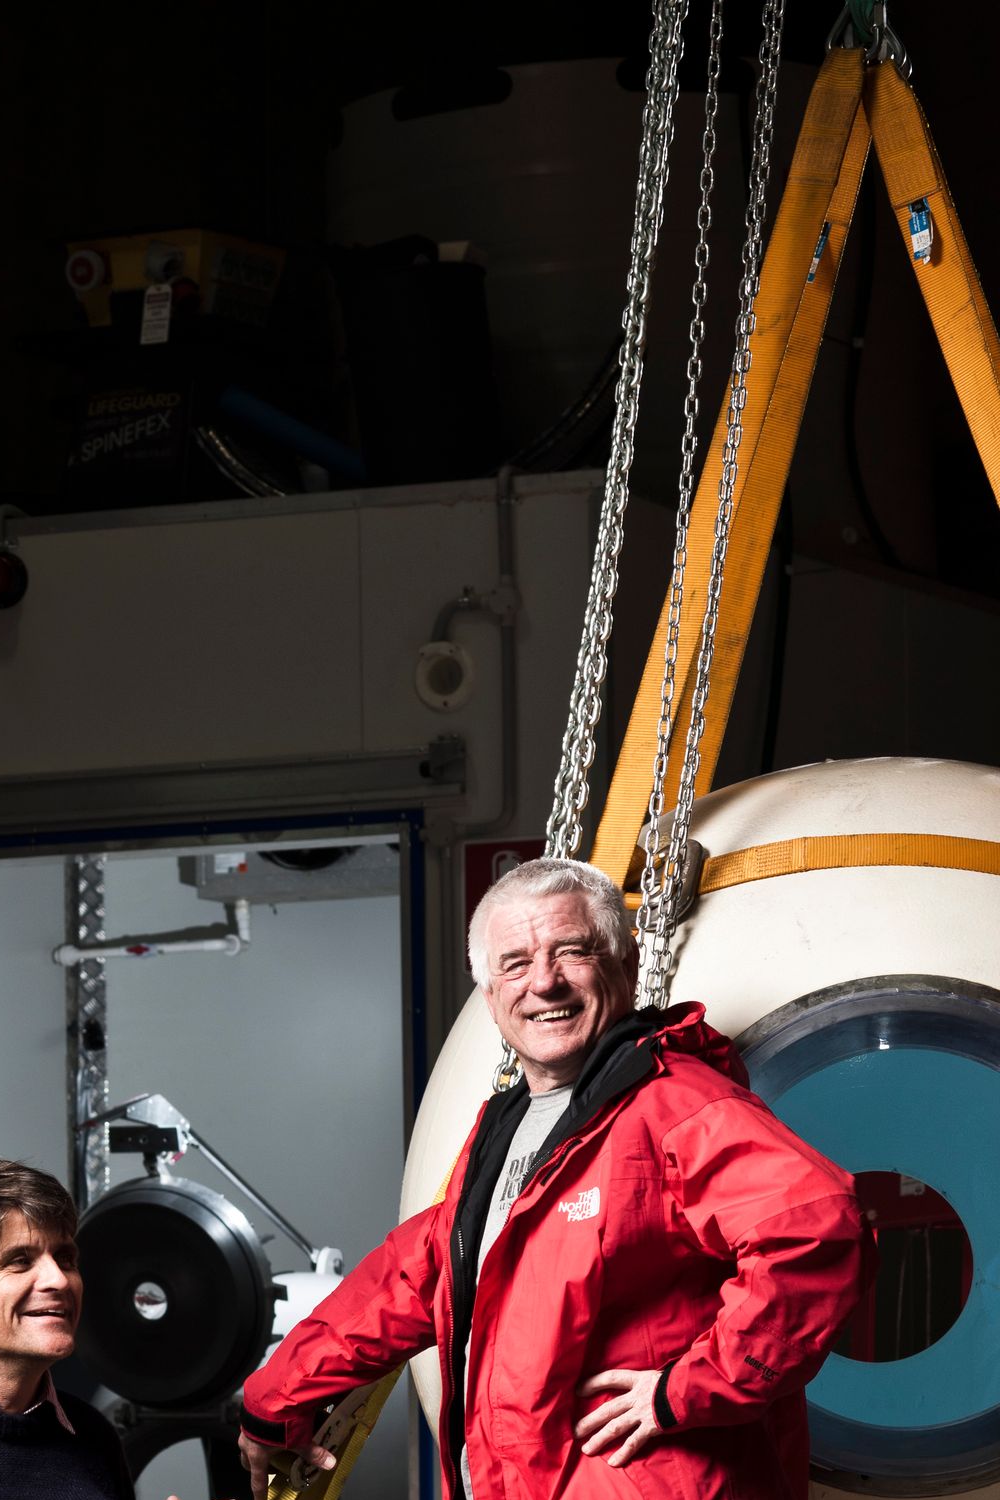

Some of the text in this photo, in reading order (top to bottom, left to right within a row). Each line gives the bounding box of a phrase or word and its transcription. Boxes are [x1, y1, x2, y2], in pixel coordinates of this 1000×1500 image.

[88, 391, 182, 416] LIFEGUARD
[81, 412, 173, 464] SPINEFEX
[577, 1190, 594, 1203] THE
[558, 1200, 592, 1213] NORTH
[567, 1210, 592, 1222] FACE
